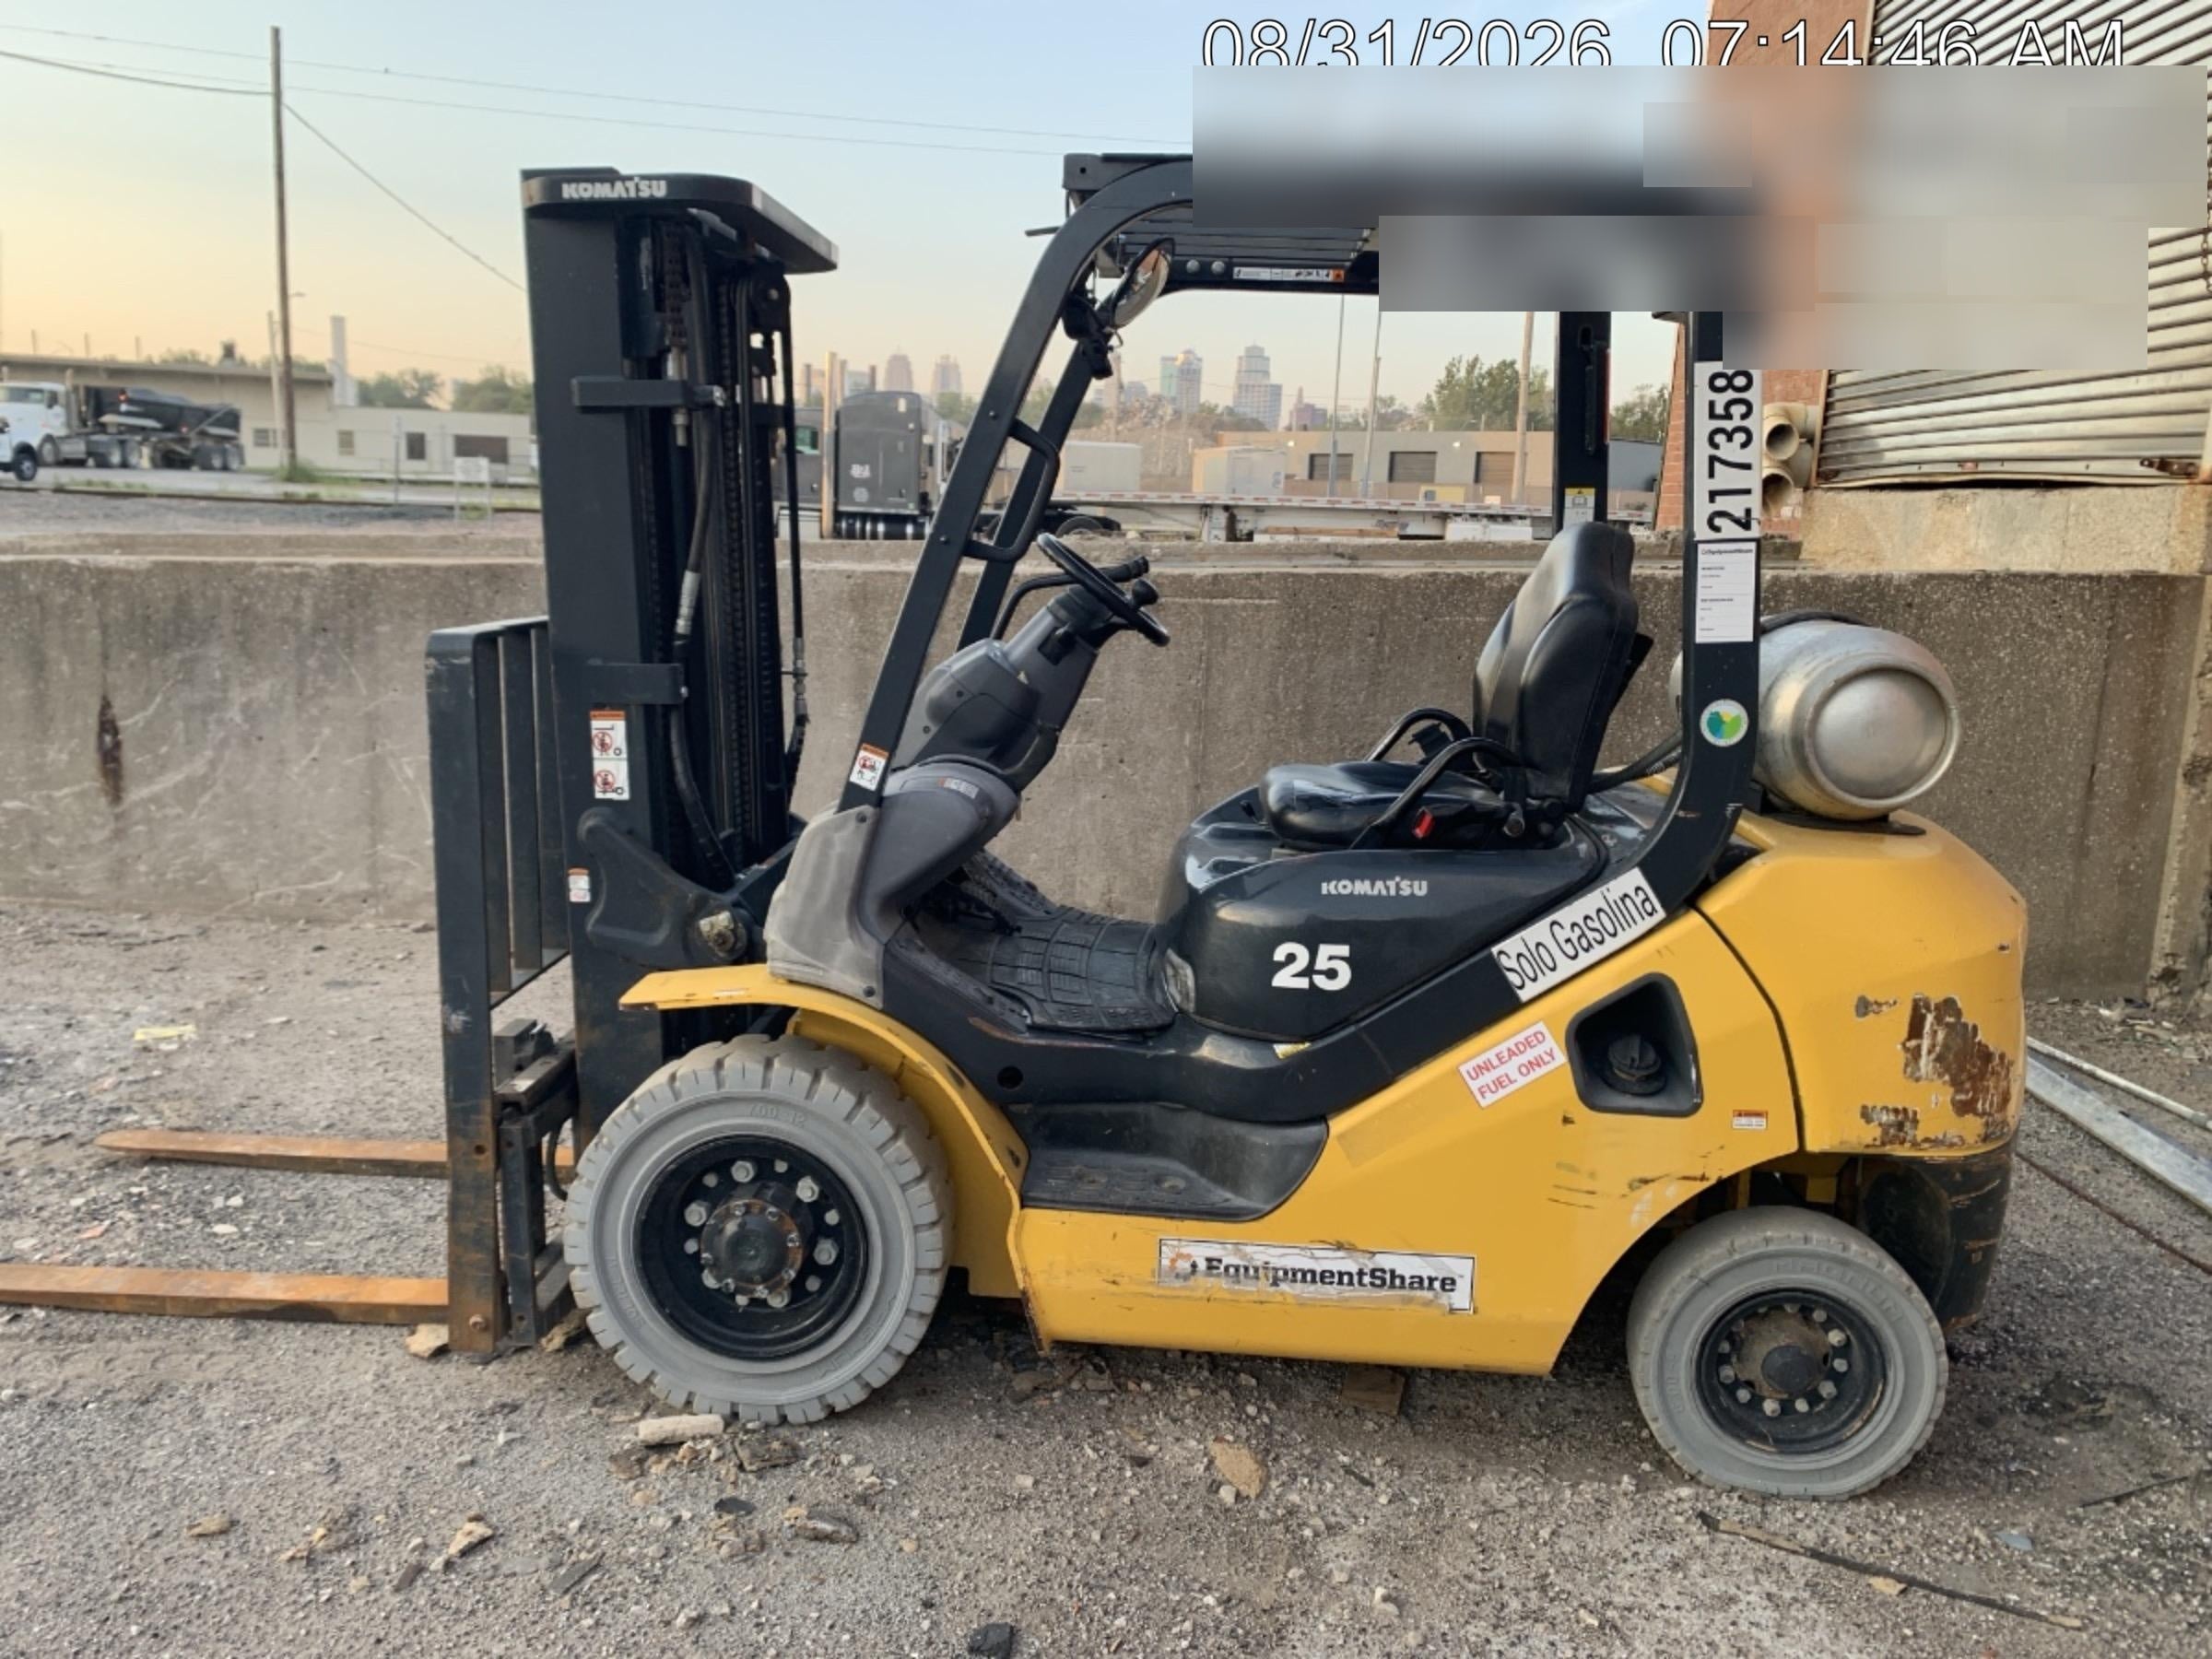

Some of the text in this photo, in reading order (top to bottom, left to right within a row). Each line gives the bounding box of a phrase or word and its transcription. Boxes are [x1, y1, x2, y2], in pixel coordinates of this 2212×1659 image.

[561, 176, 667, 199] KOMATSU
[1707, 370, 1753, 533] 217358
[1321, 876, 1428, 897] KOMATSU
[1497, 885, 1658, 991] Solo Gasolina
[1271, 941, 1352, 991] 25
[1466, 1030, 1546, 1081] UNLEADED
[1477, 1047, 1556, 1100] FUEL ONLY
